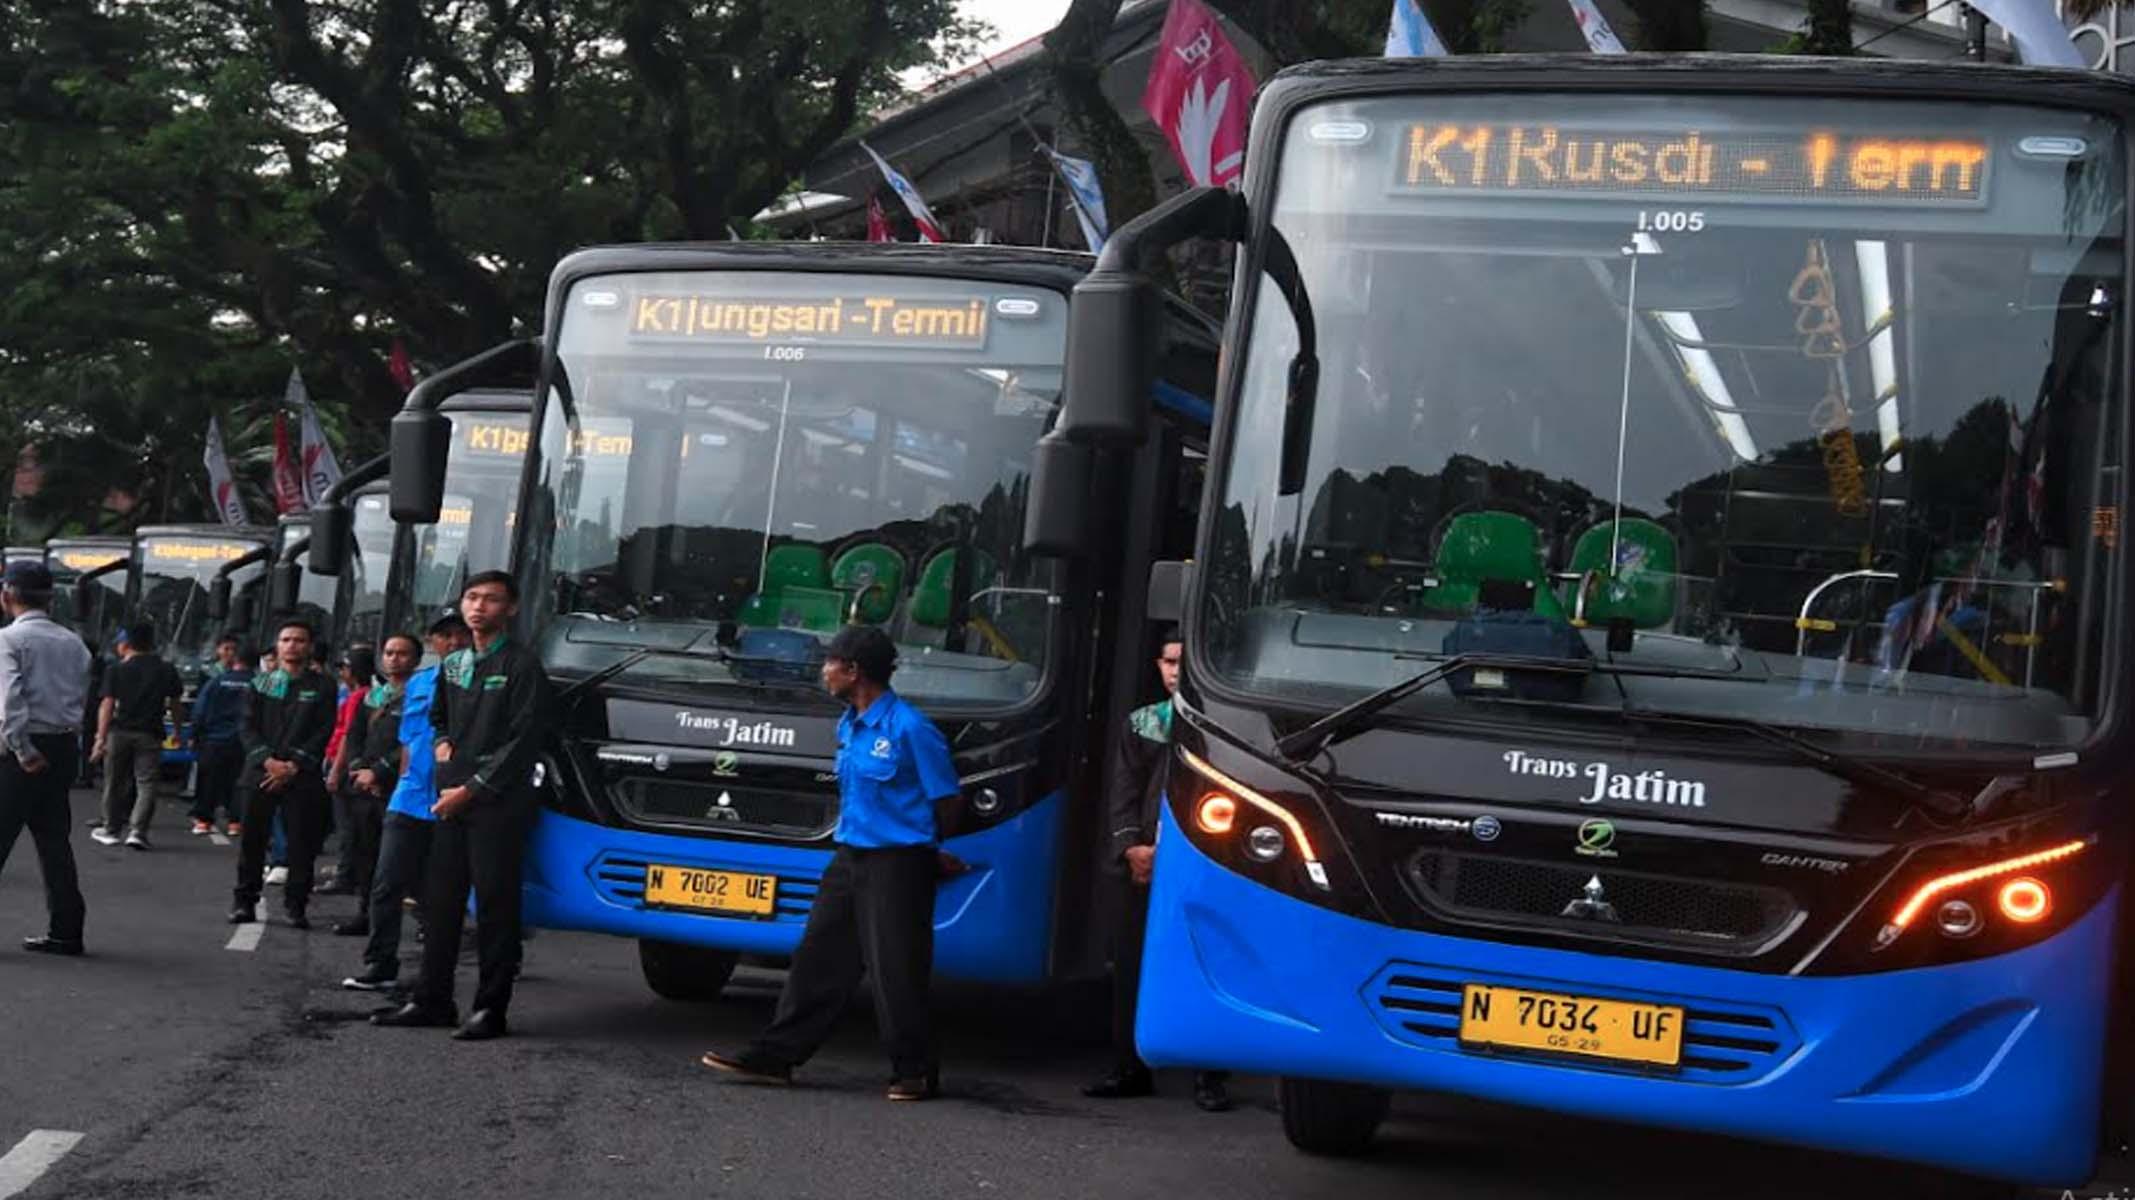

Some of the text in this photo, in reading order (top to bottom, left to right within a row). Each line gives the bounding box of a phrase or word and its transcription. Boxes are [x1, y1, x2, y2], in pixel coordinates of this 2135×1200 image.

[1406, 126, 1494, 188] K1
[675, 711, 796, 746] Trans Jatim
[1503, 750, 1706, 807] Trans Jatim
[650, 869, 770, 900] N 7002 UE
[1470, 991, 1674, 1042] N 7034 UF
